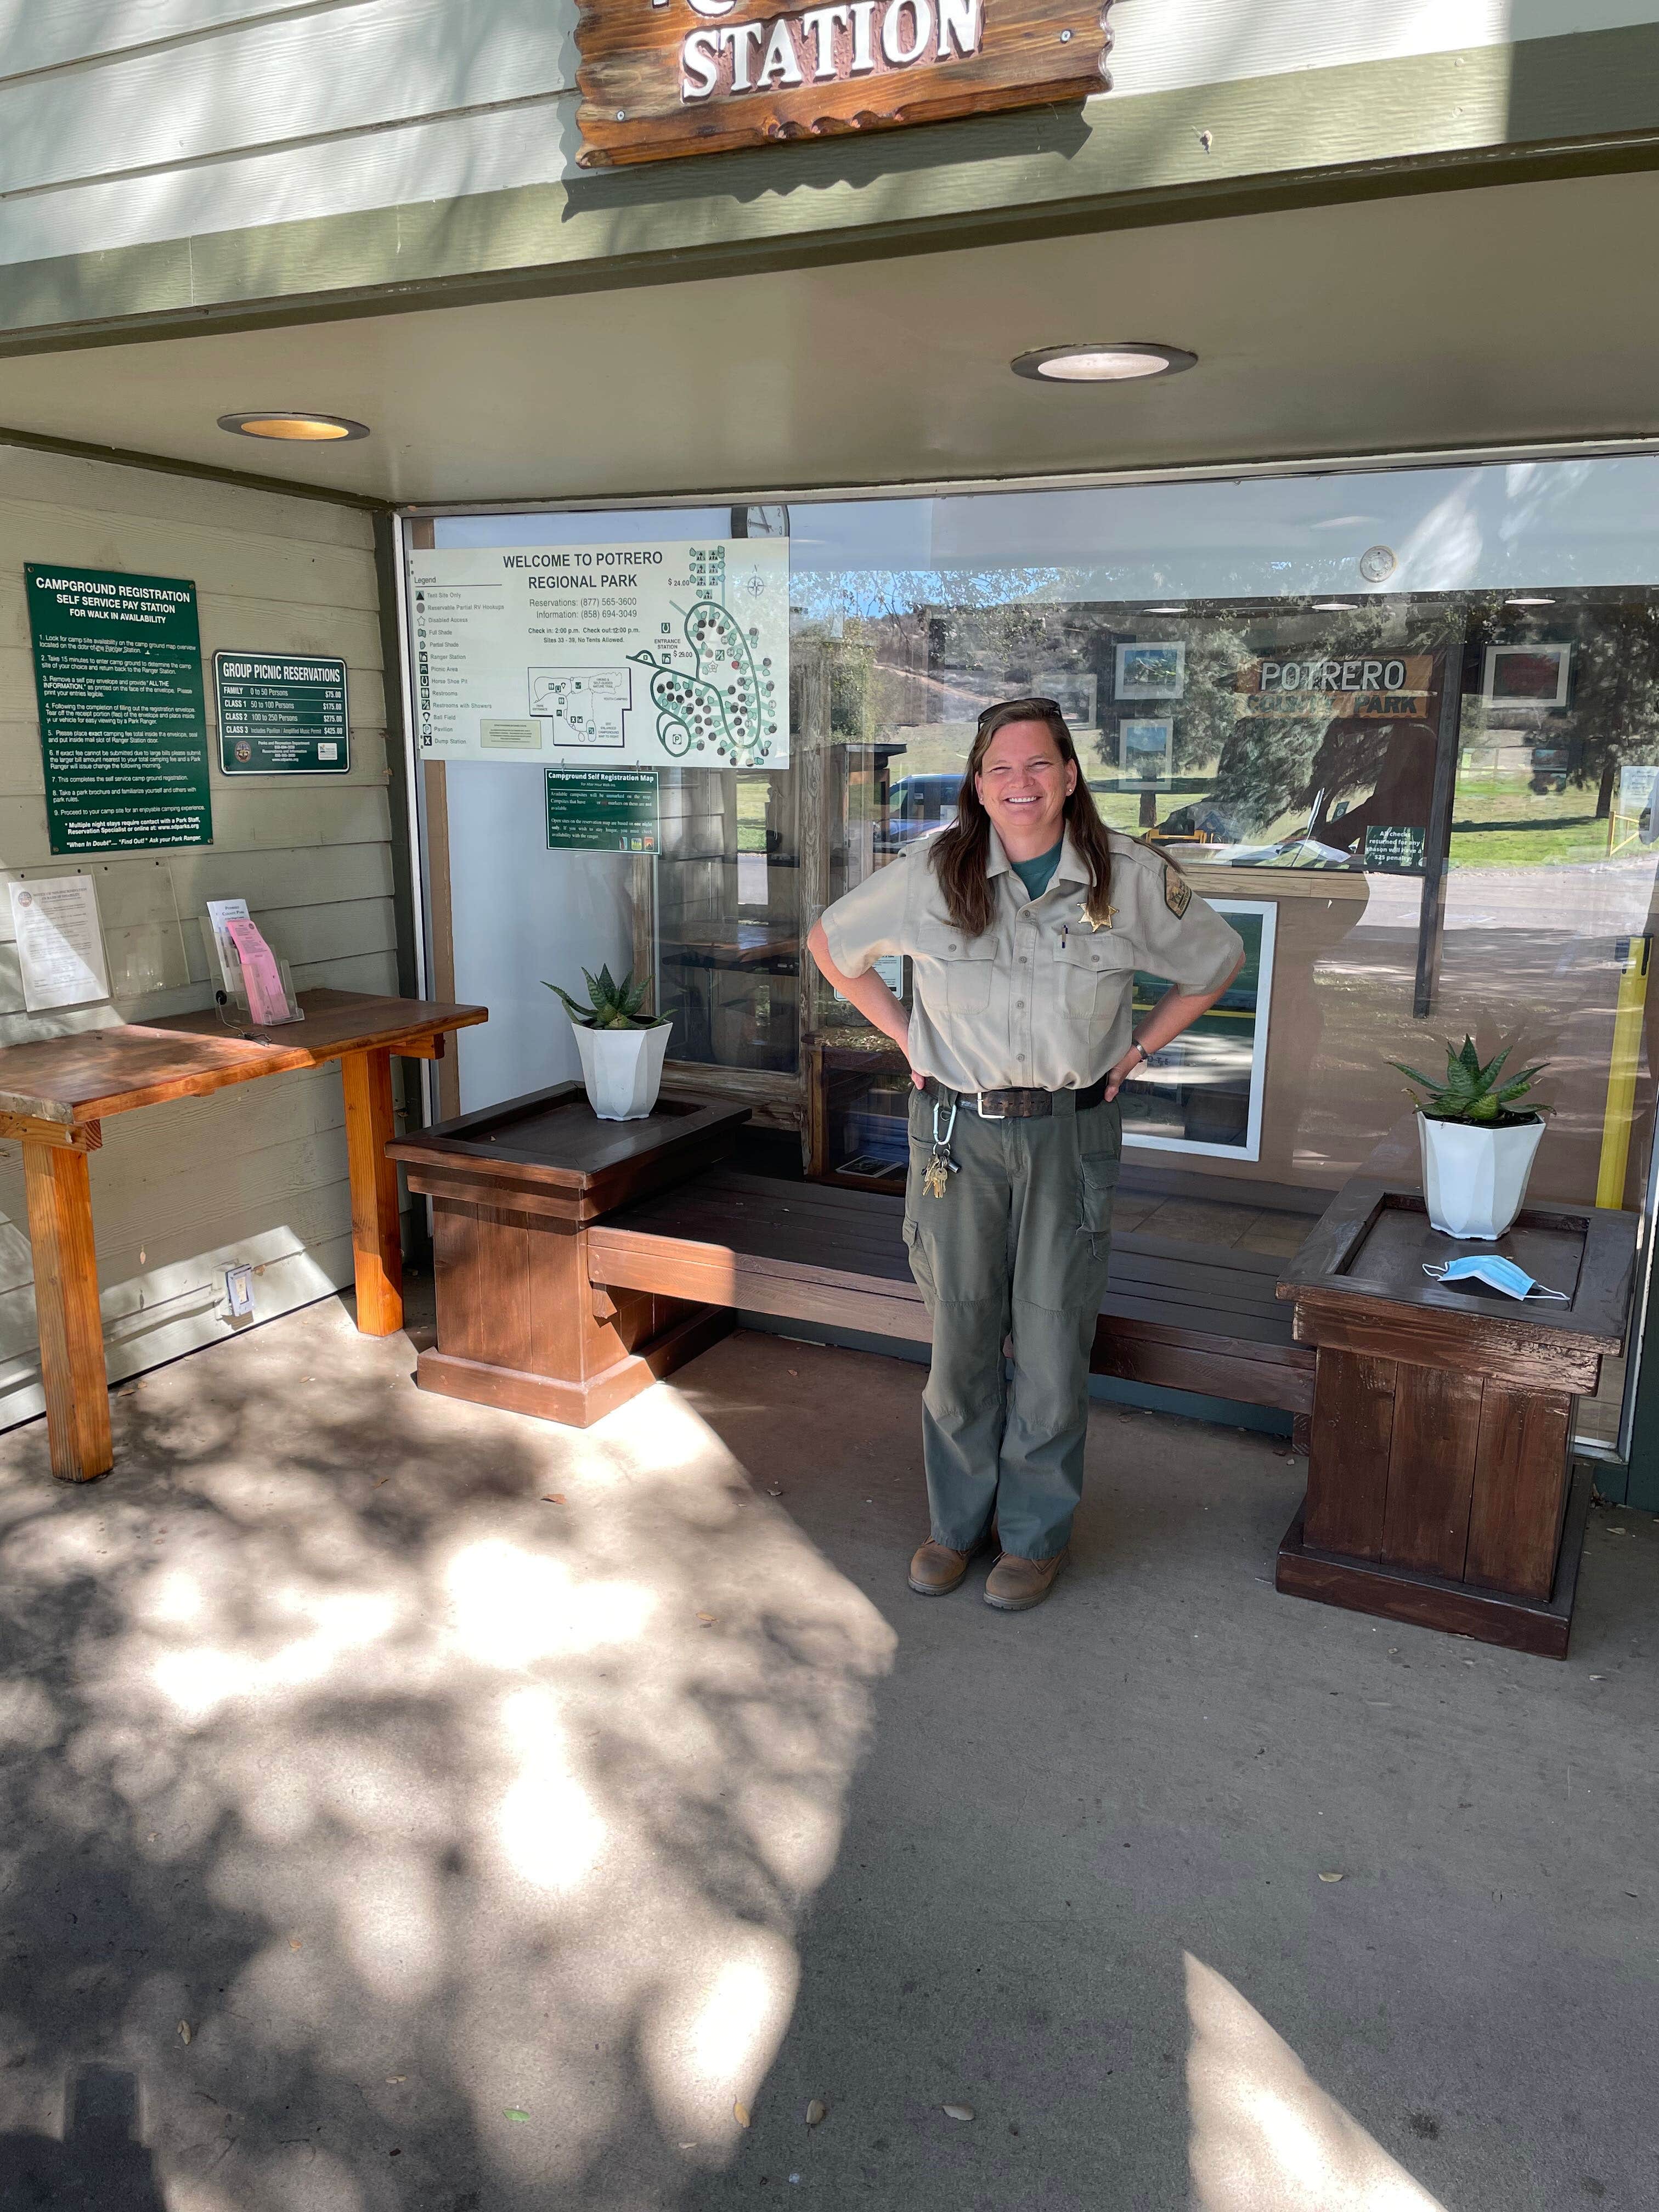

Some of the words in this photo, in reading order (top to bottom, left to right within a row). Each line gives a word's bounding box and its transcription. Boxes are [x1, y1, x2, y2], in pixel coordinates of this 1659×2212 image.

[682, 0, 980, 99] STATION
[779, 526, 782, 535] 3
[503, 554, 570, 568] WELCOME
[574, 554, 591, 566] TO
[597, 551, 662, 565] POTRERO
[36, 578, 116, 595] CAMPGROUND
[119, 586, 190, 602] REGISTRATION
[529, 575, 596, 589] REGIONAL
[601, 574, 637, 587] PARK
[57, 594, 79, 604] SELF
[82, 596, 121, 608] SERVICE
[123, 600, 138, 610] PAY
[141, 602, 175, 613] STATION
[530, 599, 578, 607] Reservations:
[581, 598, 599, 607] (877)
[602, 597, 636, 606] 565-3600
[70, 608, 86, 617] FOR
[87, 610, 109, 619] WALK
[121, 613, 166, 623] AVAILABILITY
[582, 610, 600, 619] (858)
[602, 610, 636, 618] 694-3049
[223, 663, 252, 678] GROUP
[254, 664, 281, 679] PICNIC
[284, 666, 340, 682] RESERVATIONS
[1261, 661, 1404, 691] POTRERO
[1353, 696, 1417, 713] PARK
